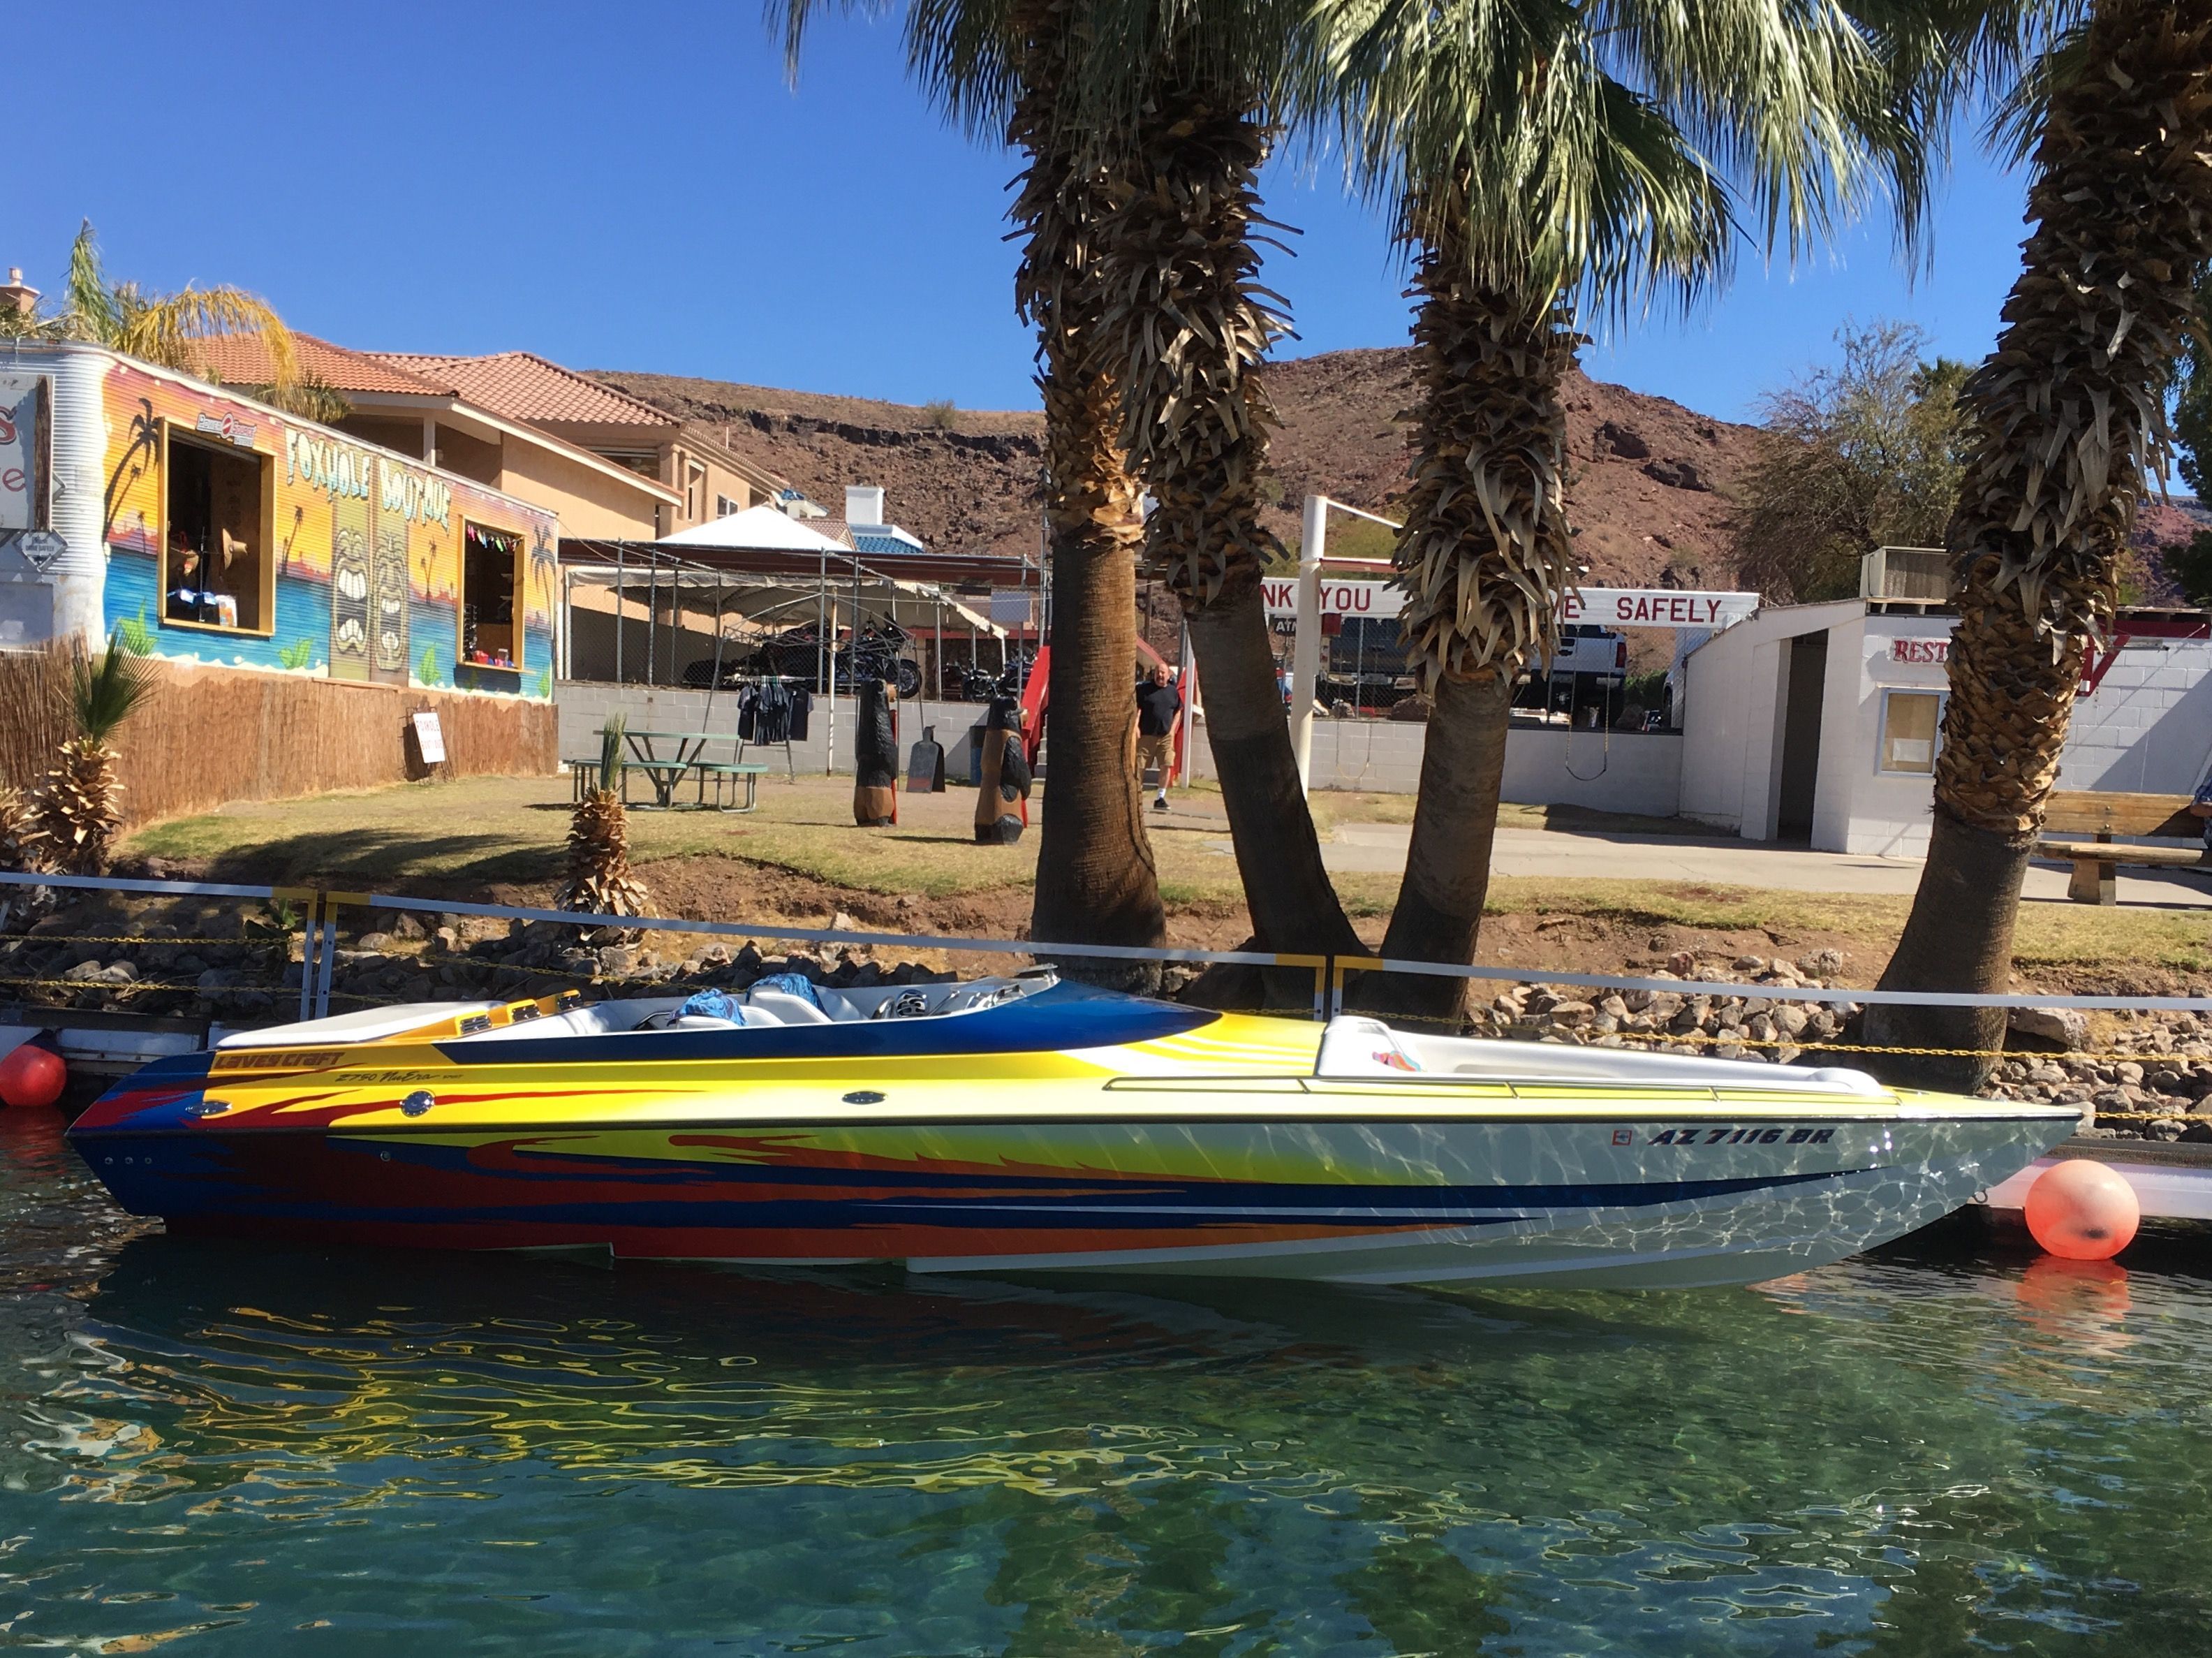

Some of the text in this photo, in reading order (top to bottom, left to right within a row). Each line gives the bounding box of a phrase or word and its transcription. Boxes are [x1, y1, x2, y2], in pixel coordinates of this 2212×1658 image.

[284, 425, 451, 536] FOXHOLE BOUTIQUE
[1260, 584, 1371, 611] NK YOU
[1616, 596, 1722, 623] SAFELY
[1893, 640, 1949, 663] REST
[334, 1073, 378, 1083] 2750
[1646, 1129, 1702, 1145] AZ
[1703, 1129, 1785, 1145] 7116
[1785, 1129, 1835, 1144] BR
